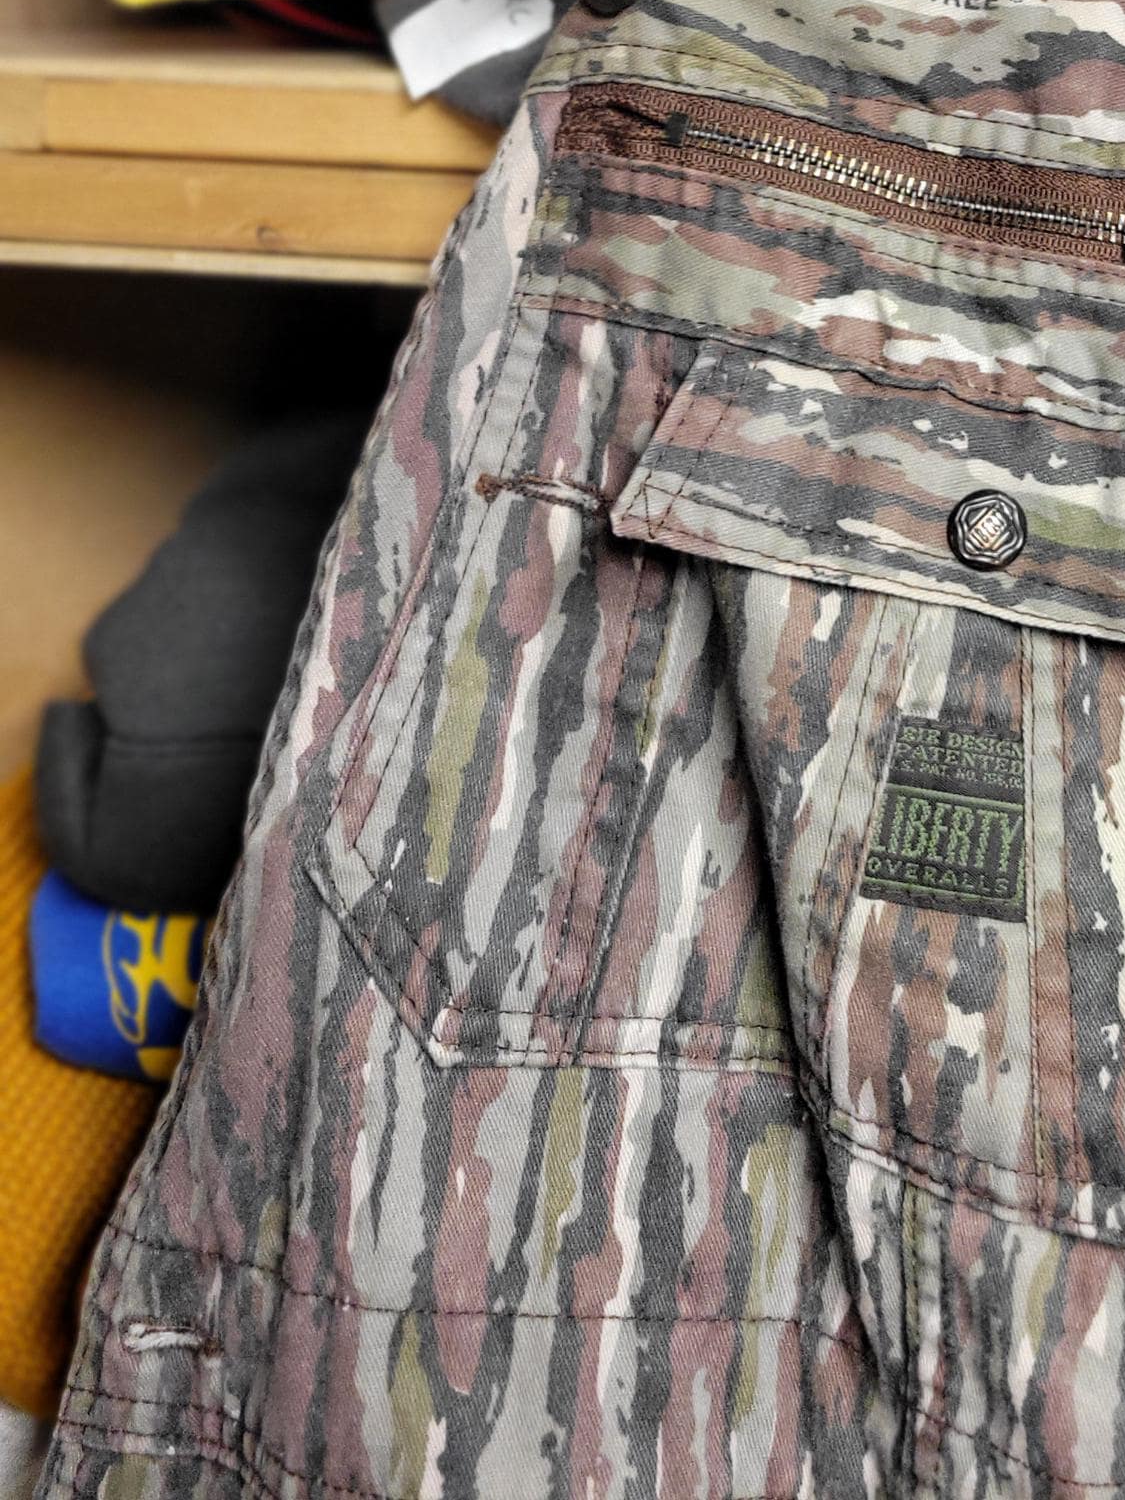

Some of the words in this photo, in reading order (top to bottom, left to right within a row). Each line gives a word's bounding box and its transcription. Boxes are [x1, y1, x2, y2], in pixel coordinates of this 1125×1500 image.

[894, 743, 1023, 775] PATENTED
[947, 732, 1022, 760] DESIGN
[870, 792, 1022, 873] LIBERTY
[867, 856, 1010, 894] OVERALLS
